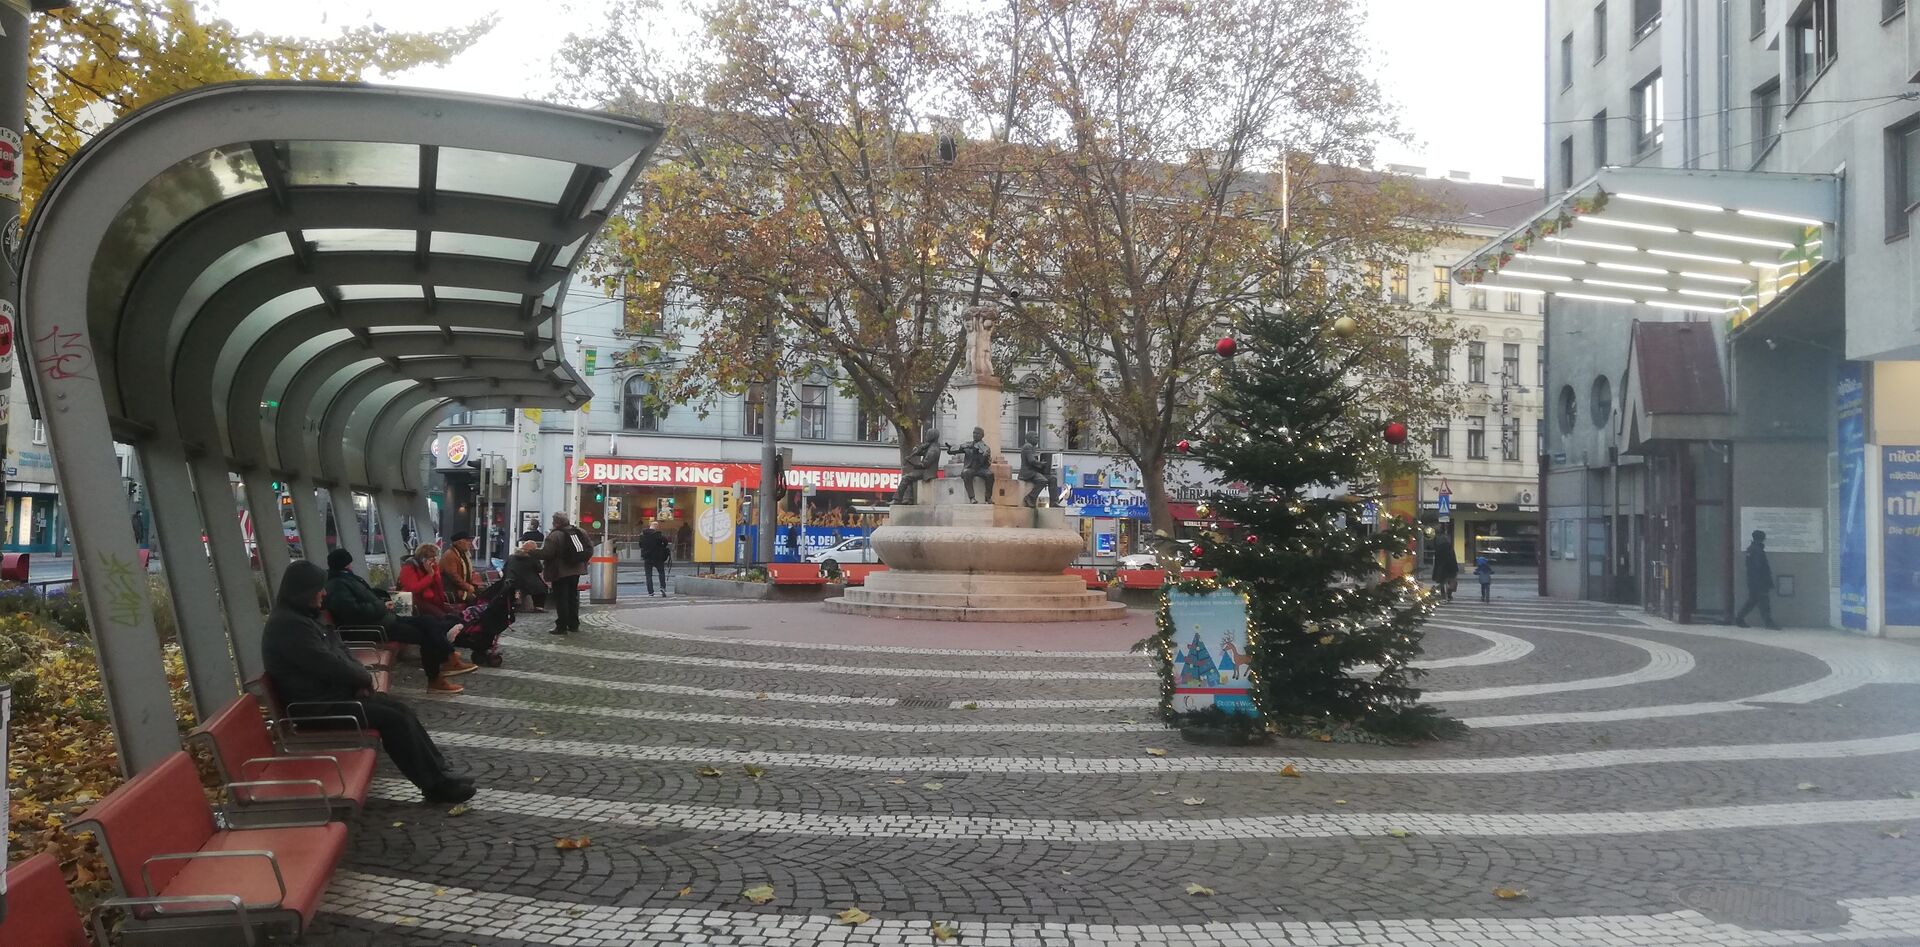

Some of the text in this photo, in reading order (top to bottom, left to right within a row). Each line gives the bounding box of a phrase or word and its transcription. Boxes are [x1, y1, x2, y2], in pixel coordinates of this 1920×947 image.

[449, 445, 465, 457] KING
[593, 464, 723, 484] BURGER KING
